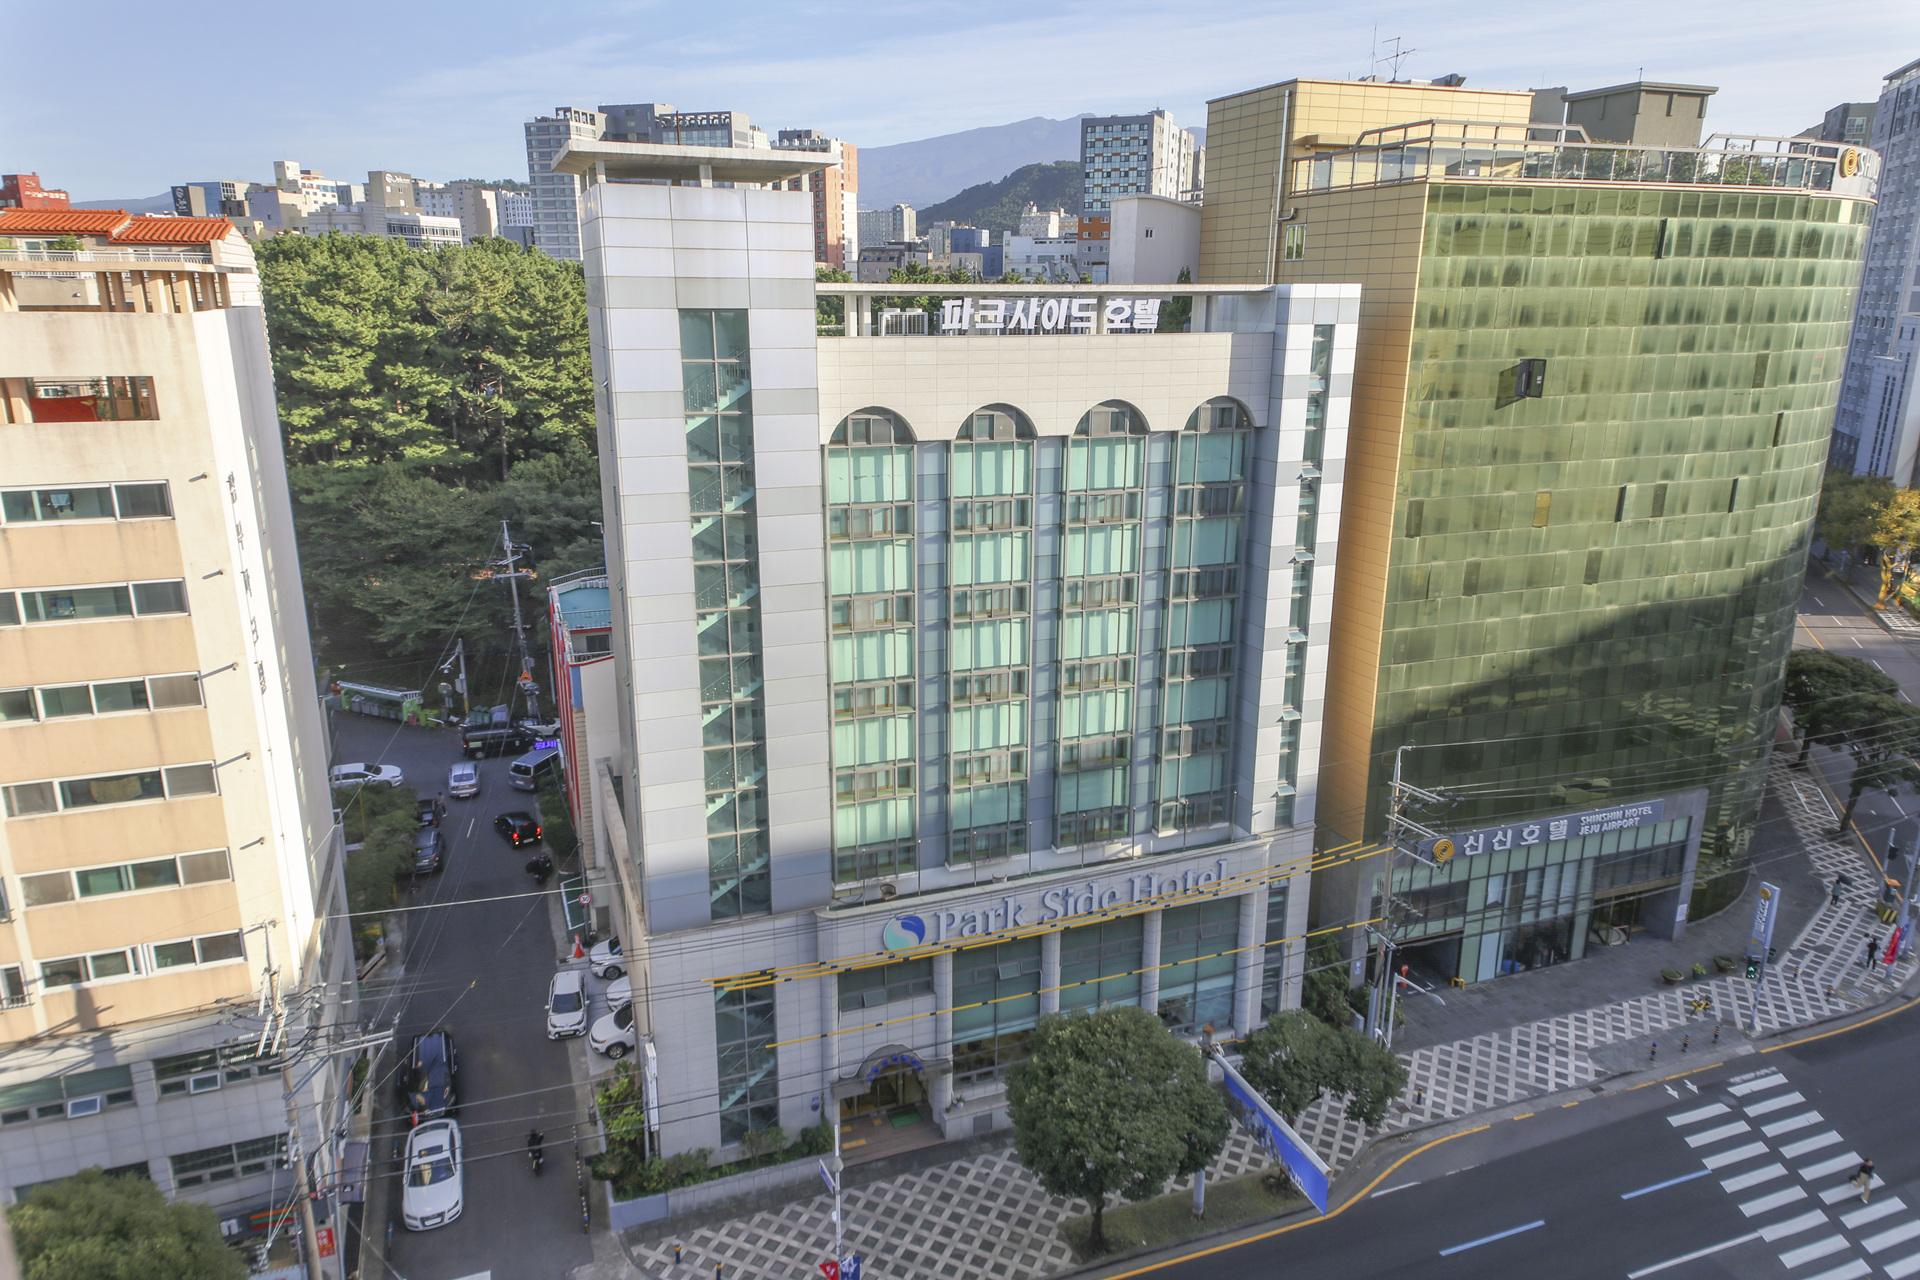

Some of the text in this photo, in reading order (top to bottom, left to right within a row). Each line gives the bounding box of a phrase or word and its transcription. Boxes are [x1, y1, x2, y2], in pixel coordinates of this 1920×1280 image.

[1578, 816, 1641, 836] JEJU AIRPORT
[1580, 806, 1653, 826] SHINSHIN HOTEL
[1463, 820, 1568, 856] 신신호텔
[935, 859, 1228, 941] Park Side Hotel
